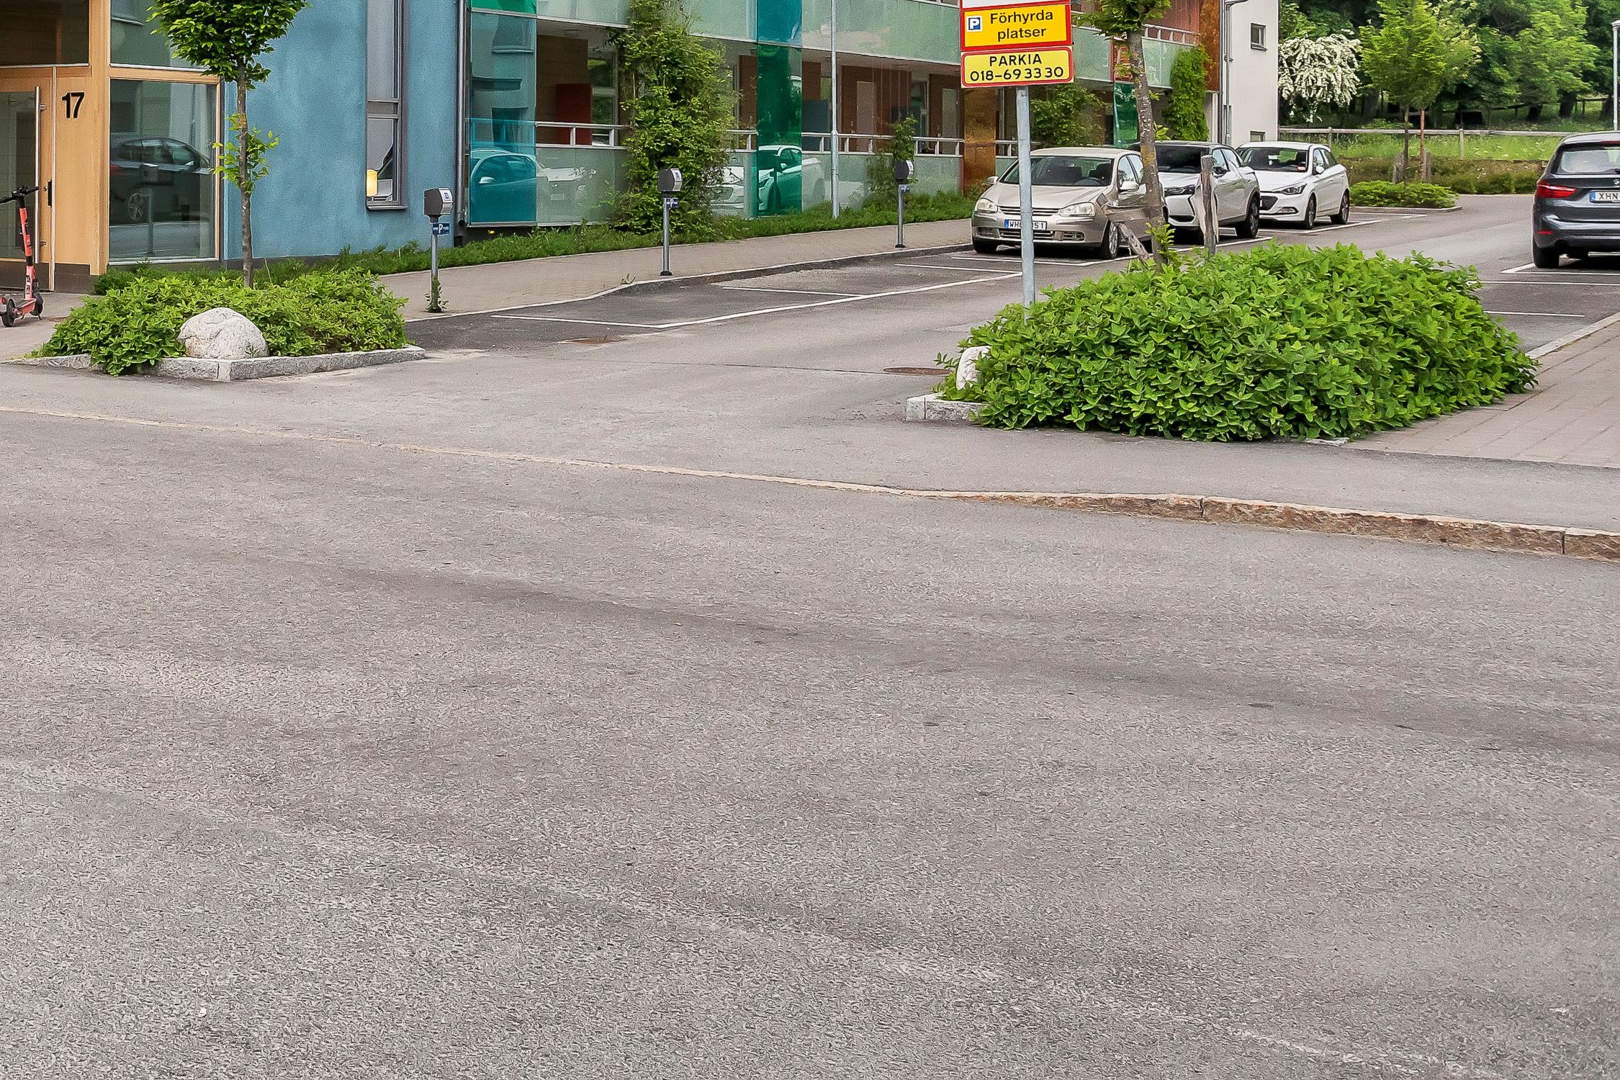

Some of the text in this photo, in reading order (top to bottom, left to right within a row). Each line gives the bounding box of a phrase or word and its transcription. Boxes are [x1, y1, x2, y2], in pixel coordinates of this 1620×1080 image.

[990, 9, 1053, 24] Förhyrda
[997, 28, 1046, 42] platser
[989, 54, 1042, 67] PARKIA
[61, 92, 85, 119] 17
